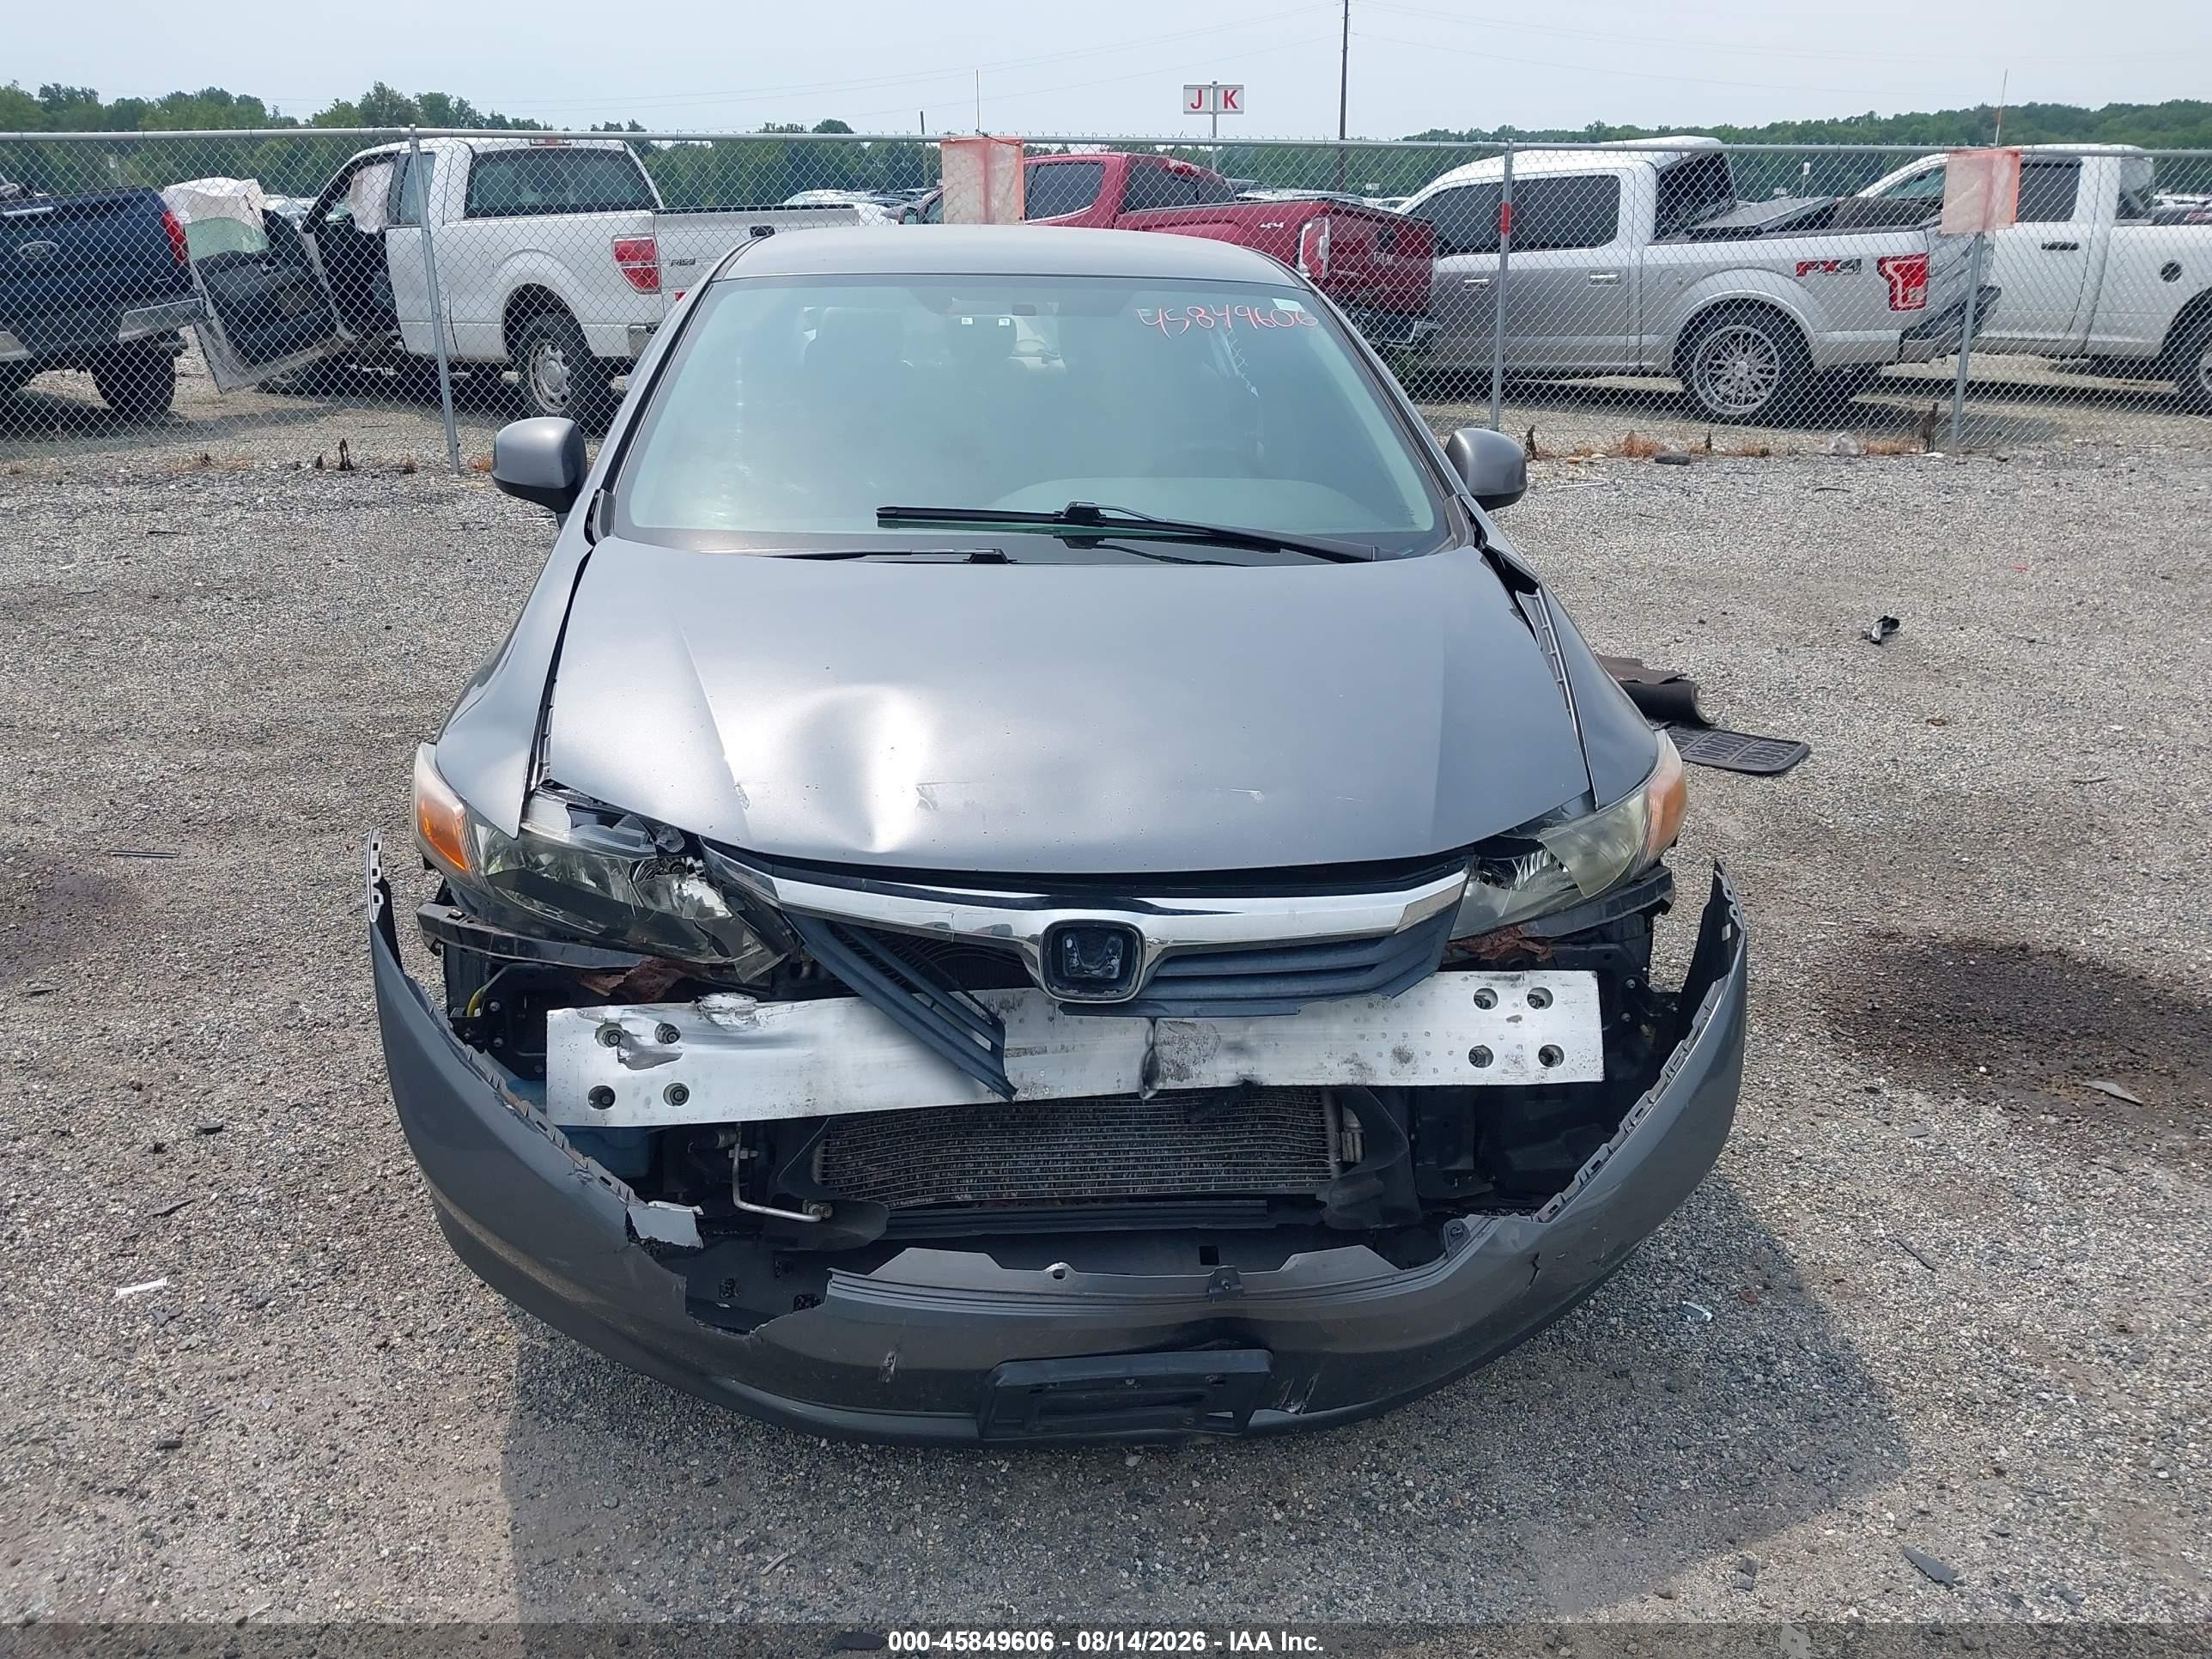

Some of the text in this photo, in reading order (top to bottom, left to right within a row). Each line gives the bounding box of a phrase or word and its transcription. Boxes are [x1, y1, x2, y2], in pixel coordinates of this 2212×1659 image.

[1190, 89, 1203, 109] J
[1224, 89, 1238, 109] K
[1796, 258, 1863, 276] FX4
[1136, 303, 1319, 340] 45849606
